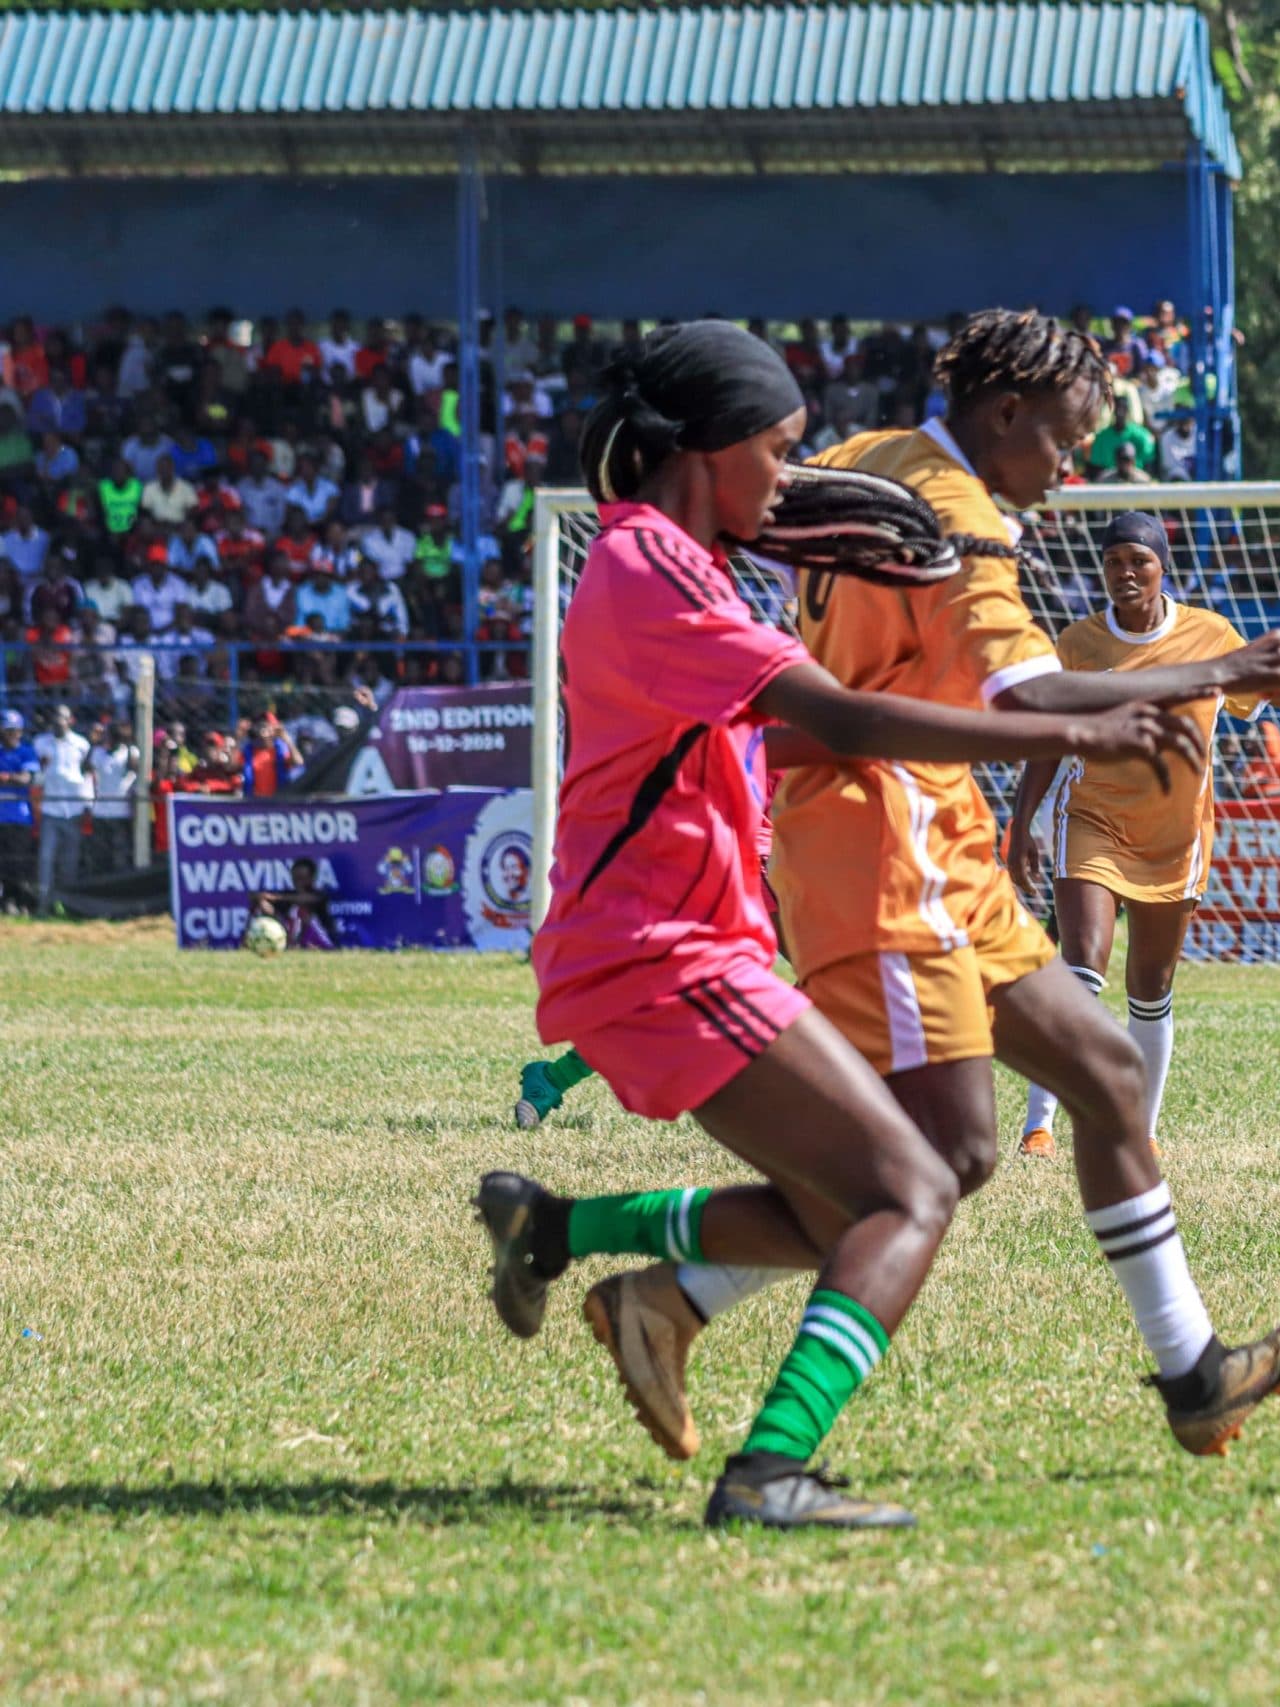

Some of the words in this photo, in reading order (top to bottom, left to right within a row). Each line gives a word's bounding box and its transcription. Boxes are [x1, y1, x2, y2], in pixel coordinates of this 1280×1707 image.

[390, 708, 440, 732] 2ND
[442, 704, 535, 730] EDITION
[179, 812, 357, 847] GOVERNOR
[180, 858, 338, 892] WAVINA
[329, 902, 373, 915] DITION
[1183, 921, 1235, 961] UP
